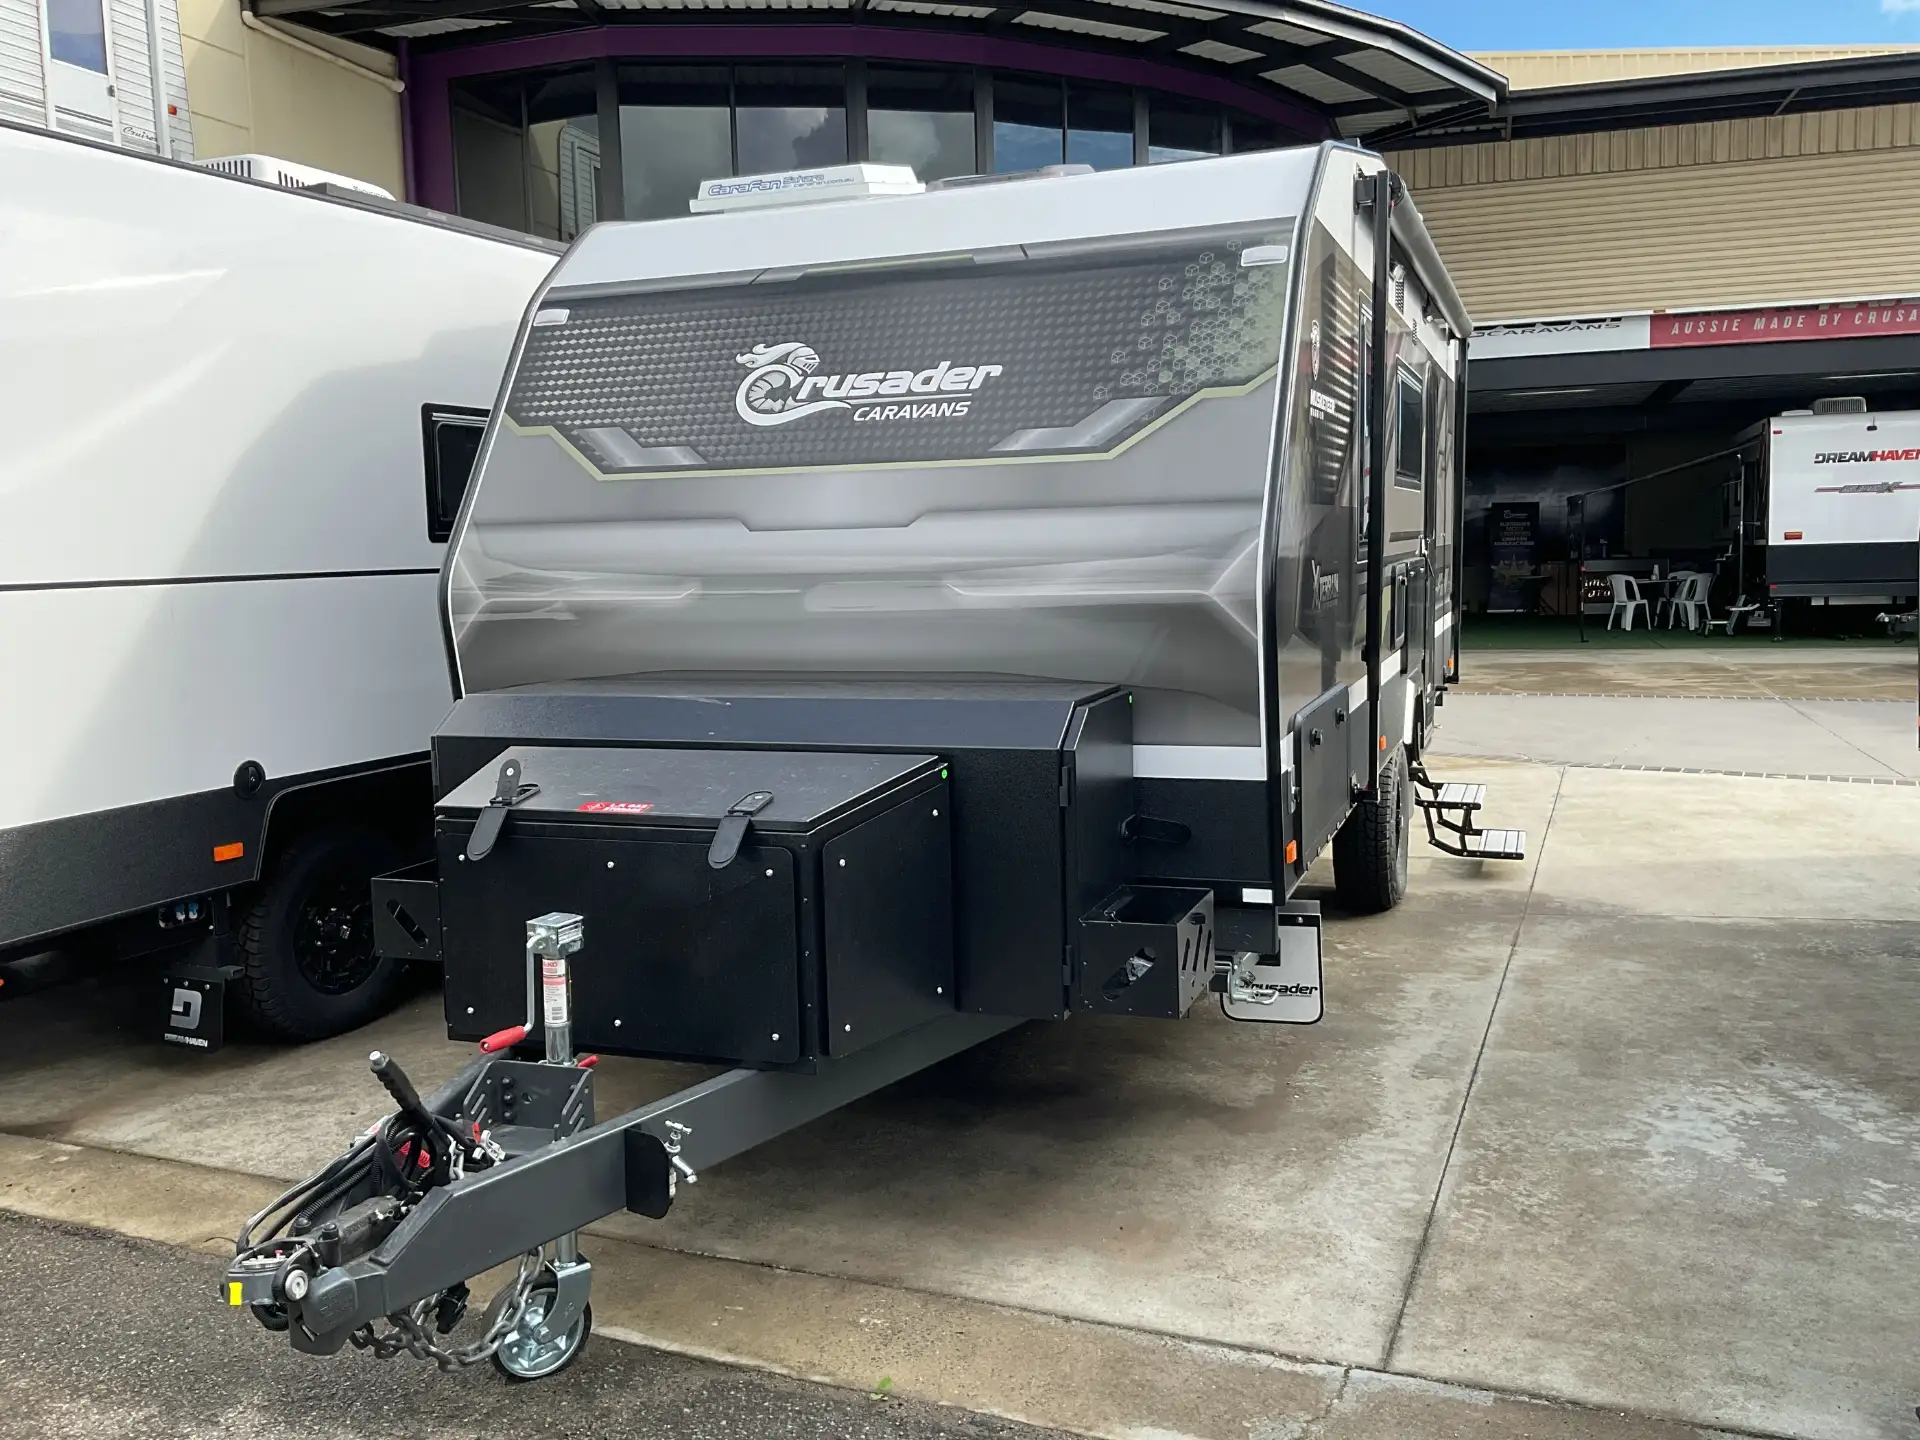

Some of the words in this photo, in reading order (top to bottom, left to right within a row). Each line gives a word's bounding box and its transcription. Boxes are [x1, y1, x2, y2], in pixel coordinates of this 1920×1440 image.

[708, 179, 782, 196] CaraFan
[1671, 319, 1741, 335] AUSSIE
[1753, 315, 1806, 331] MADE
[1818, 312, 1841, 327] BY
[1854, 309, 1918, 325] CRUSA
[735, 360, 1004, 427] Crusader
[853, 401, 972, 422] CARAVANS
